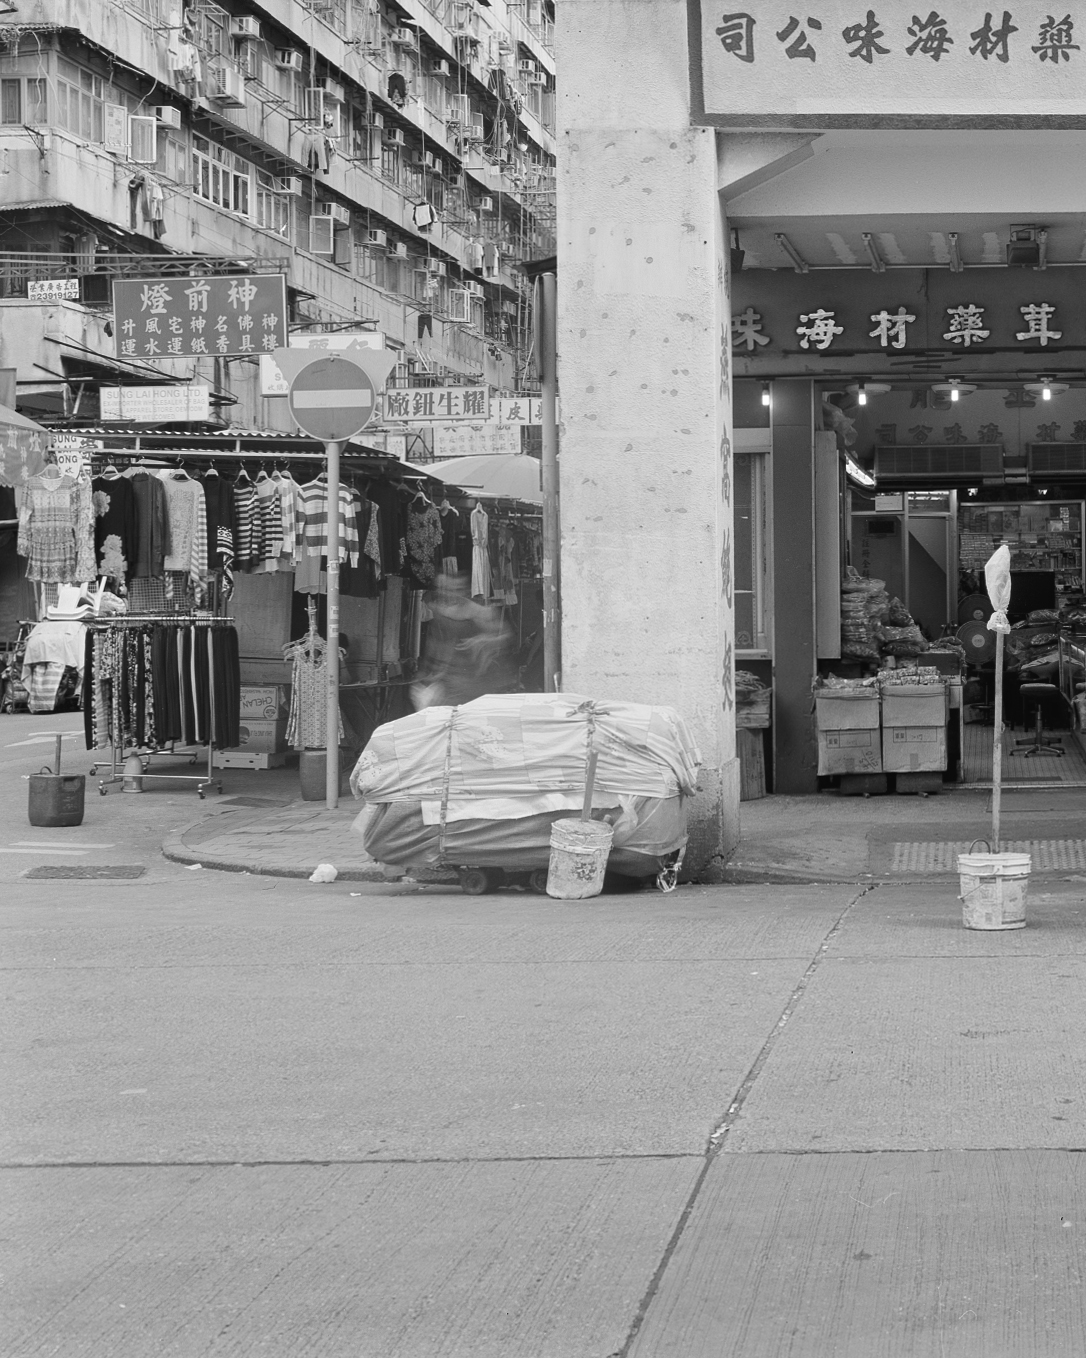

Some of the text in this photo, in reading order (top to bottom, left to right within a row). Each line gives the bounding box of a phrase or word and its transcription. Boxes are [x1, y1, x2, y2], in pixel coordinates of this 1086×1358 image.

[140, 278, 258, 315] 神前燈
[106, 390, 133, 399] SUNG
[136, 390, 151, 399] LAI
[153, 389, 180, 398] HONG
[53, 435, 77, 443] SUNG
[58, 455, 78, 464] ONG
[242, 696, 273, 709] CHELAN
